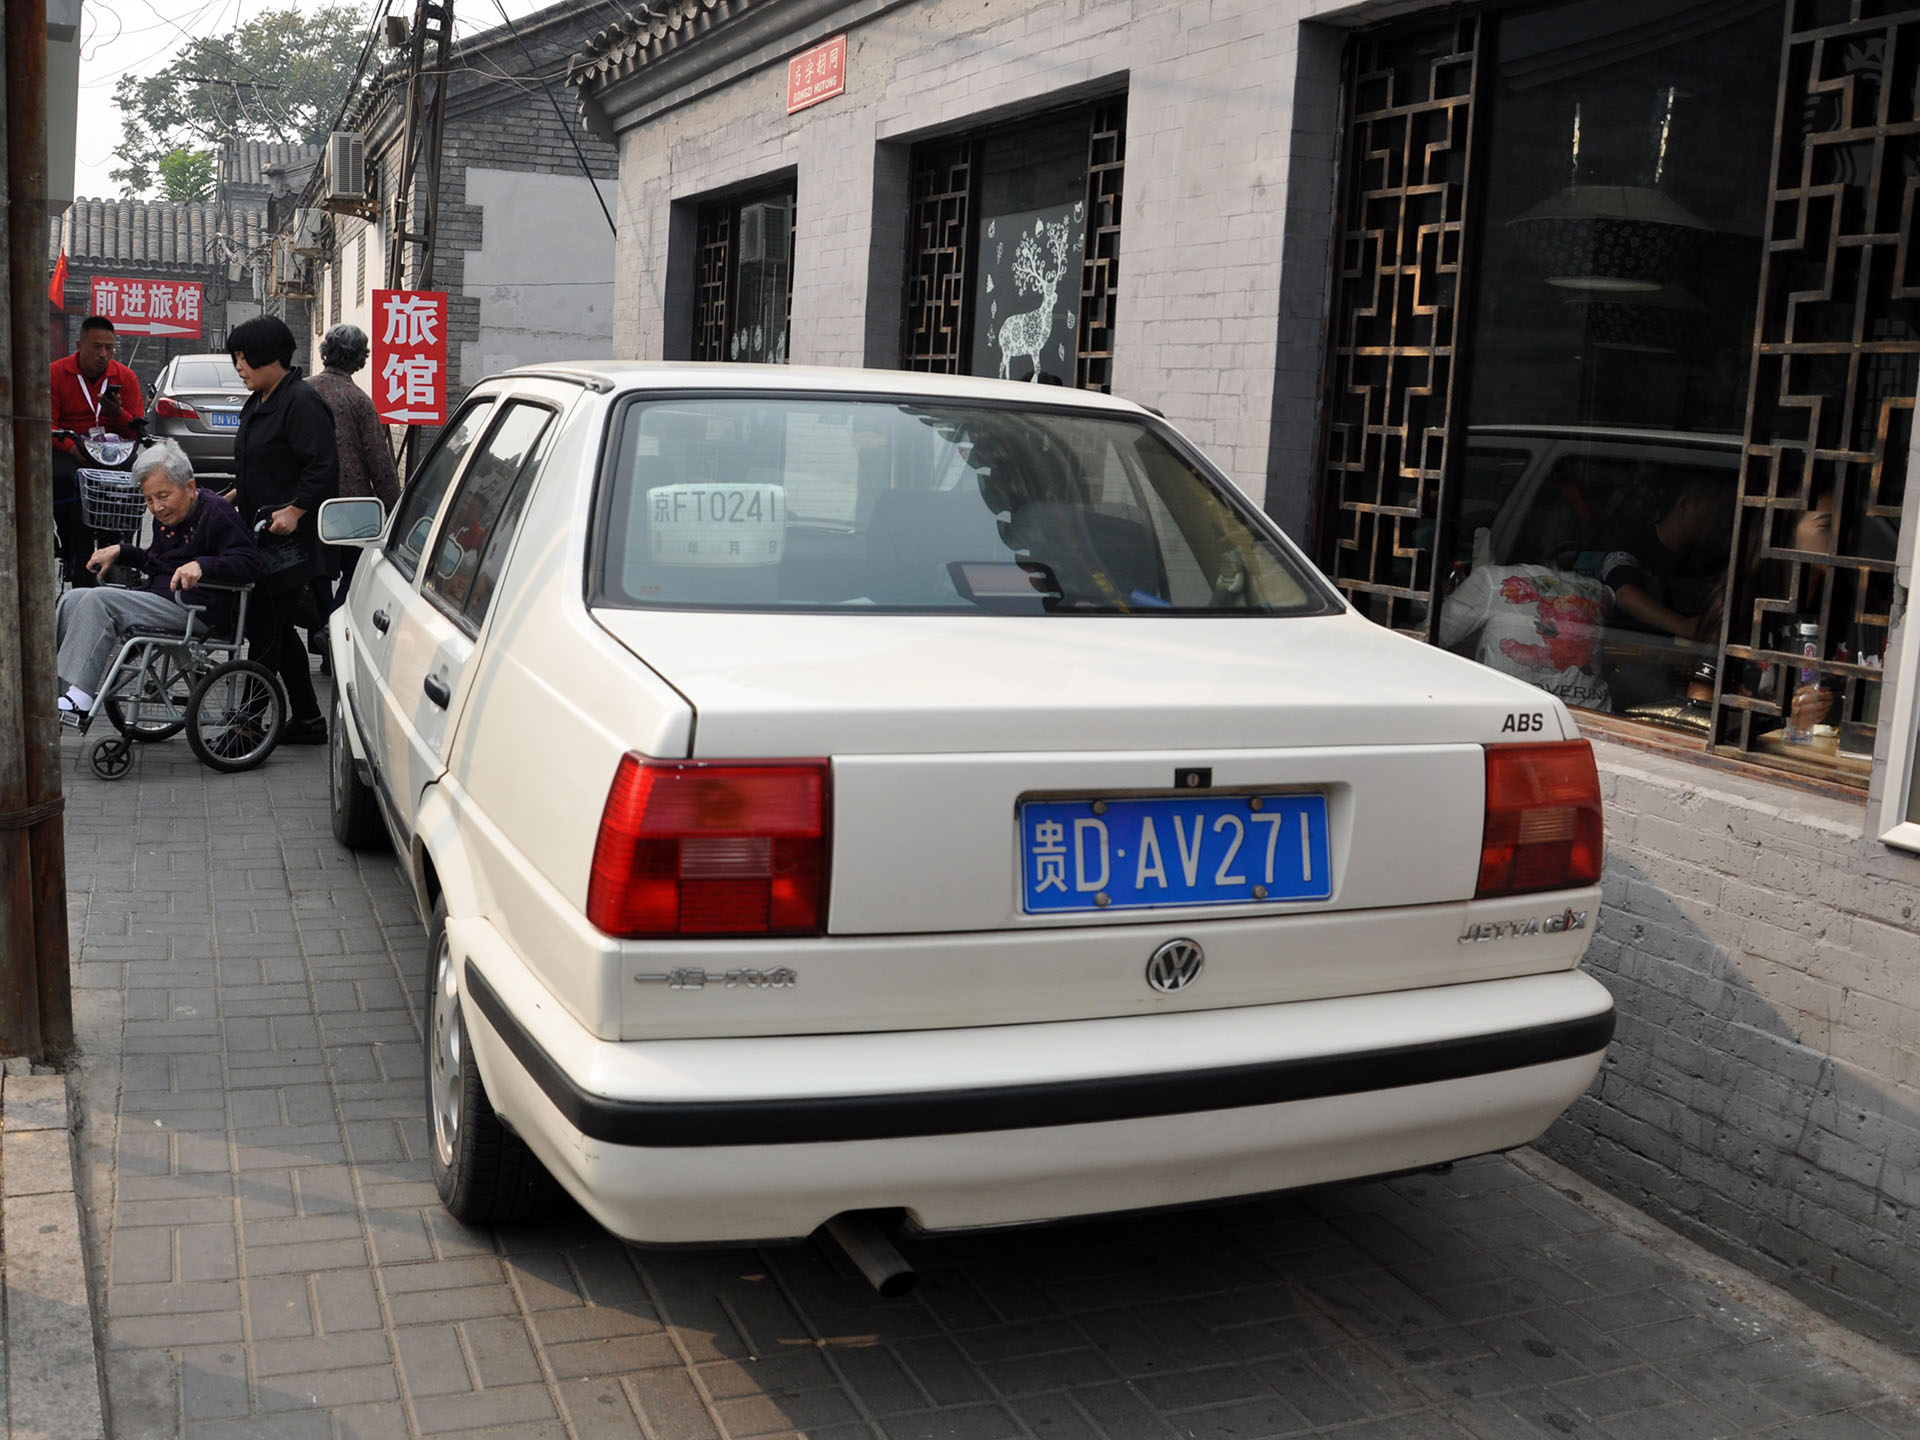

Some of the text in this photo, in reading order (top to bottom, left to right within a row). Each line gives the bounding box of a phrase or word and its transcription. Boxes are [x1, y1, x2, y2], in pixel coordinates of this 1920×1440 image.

[795, 47, 839, 86] 弓字胡同
[793, 75, 838, 104] GONGZI HUTONG
[94, 281, 200, 321] 前进旅馆
[382, 295, 439, 405] 旅馆
[654, 491, 776, 523] 京FT0241
[729, 541, 741, 555] 月
[1501, 713, 1544, 733] ABS
[1458, 917, 1539, 945] JETTA
